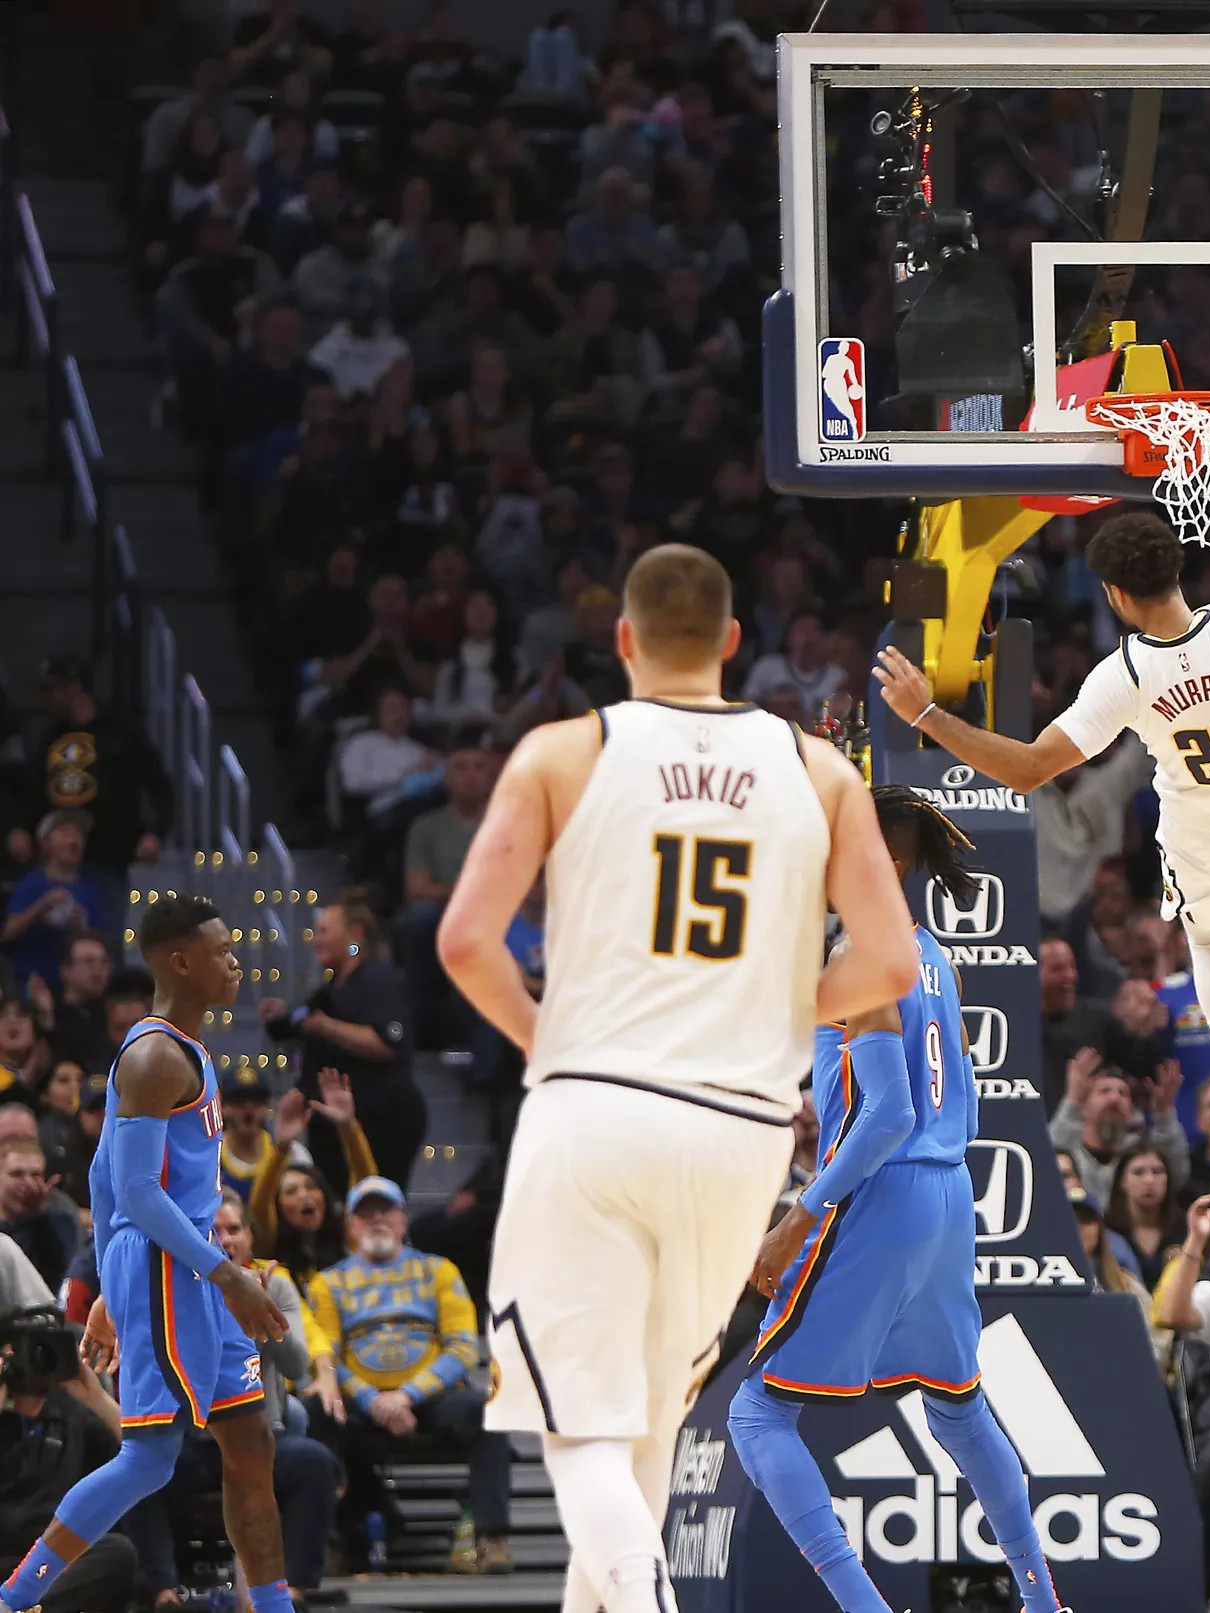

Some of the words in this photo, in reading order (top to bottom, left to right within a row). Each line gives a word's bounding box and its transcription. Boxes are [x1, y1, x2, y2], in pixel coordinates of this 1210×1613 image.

[826, 419, 849, 437] NBA
[820, 446, 891, 463] SPALDING
[909, 786, 1028, 814] PALDING
[650, 832, 755, 963] 15
[940, 945, 1038, 966] NDA
[925, 1018, 945, 1112] 9
[974, 1255, 1086, 1287] NDA
